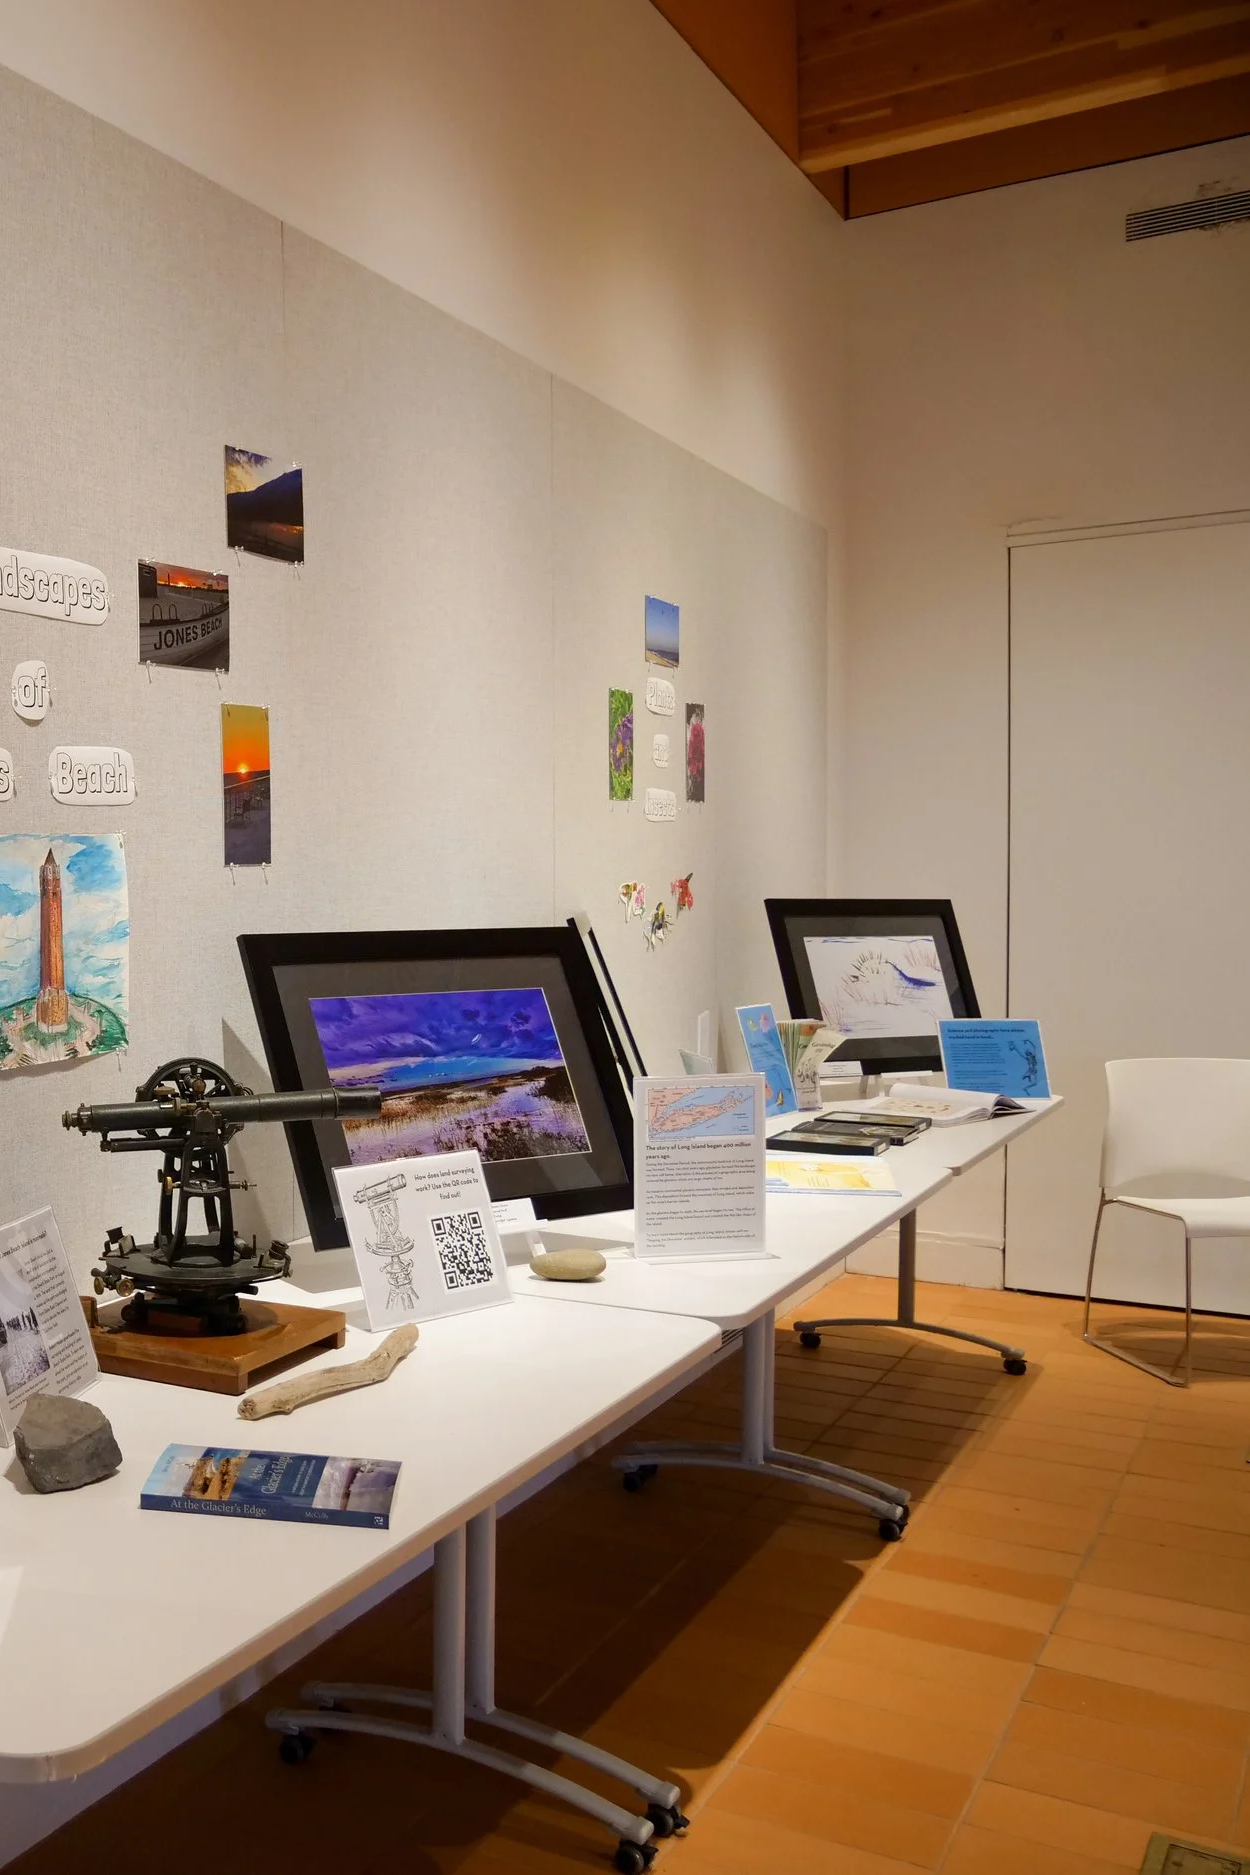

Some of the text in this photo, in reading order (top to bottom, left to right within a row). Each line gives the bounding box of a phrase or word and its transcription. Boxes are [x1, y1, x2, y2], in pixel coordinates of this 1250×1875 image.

[154, 617, 222, 650] JONES BEACH
[18, 666, 46, 707] of
[647, 681, 674, 709] Plants
[57, 752, 128, 795] Beach
[440, 1169, 450, 1177] land
[415, 1184, 431, 1192] work?
[170, 1500, 267, 1517] At the Glacier's Edge
